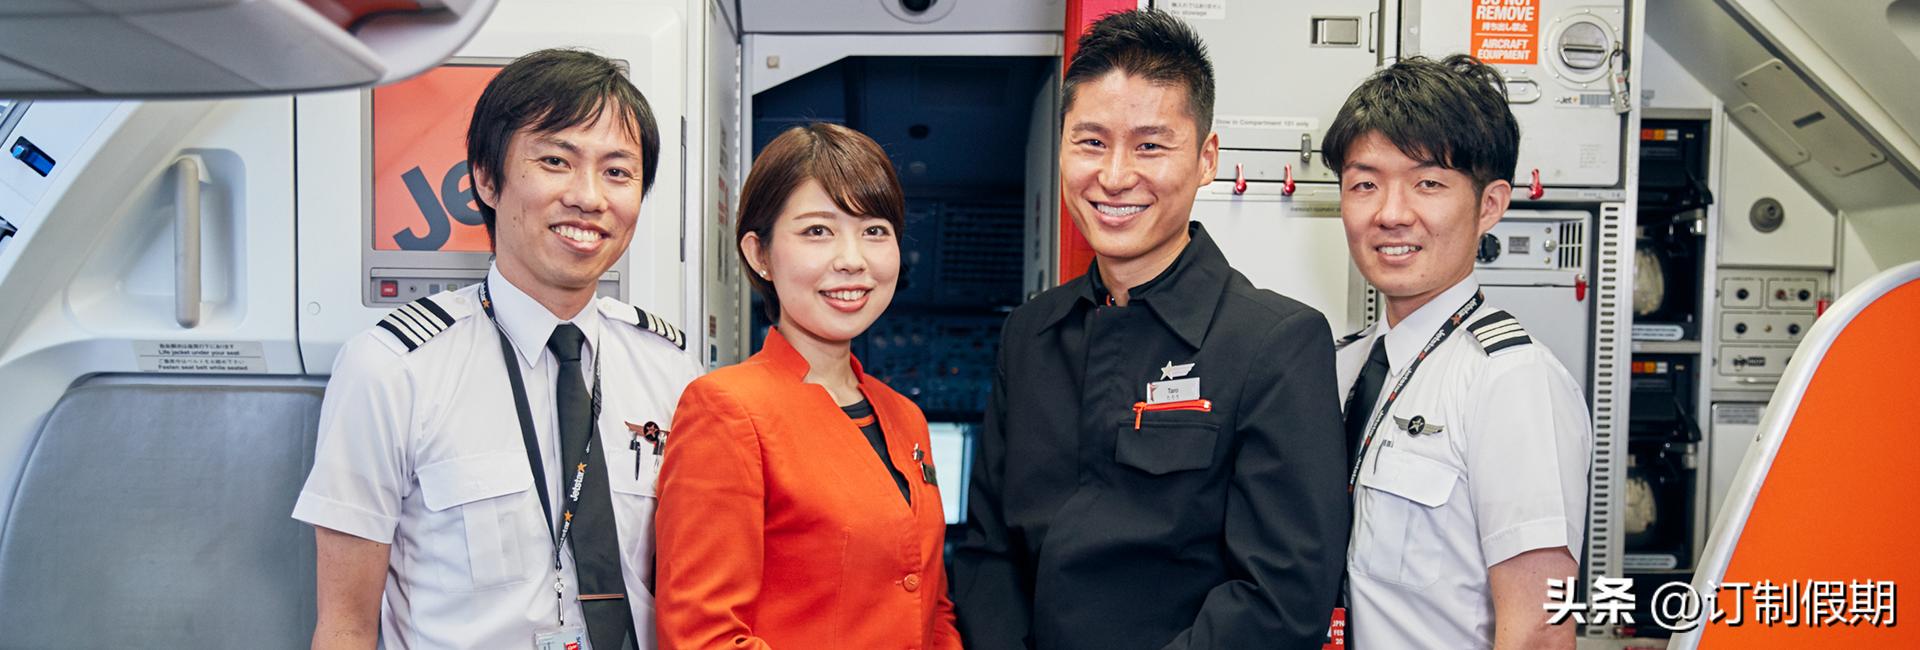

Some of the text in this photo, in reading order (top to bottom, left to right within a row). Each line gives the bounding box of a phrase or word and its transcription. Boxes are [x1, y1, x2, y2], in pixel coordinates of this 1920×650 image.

[1476, 6, 1535, 21] REMOVE
[1481, 38, 1529, 49] AIRCRAFT
[1477, 49, 1532, 60] EQUIPMENT
[1457, 297, 1478, 318] Jetstar
[570, 471, 585, 502] Jetstar
